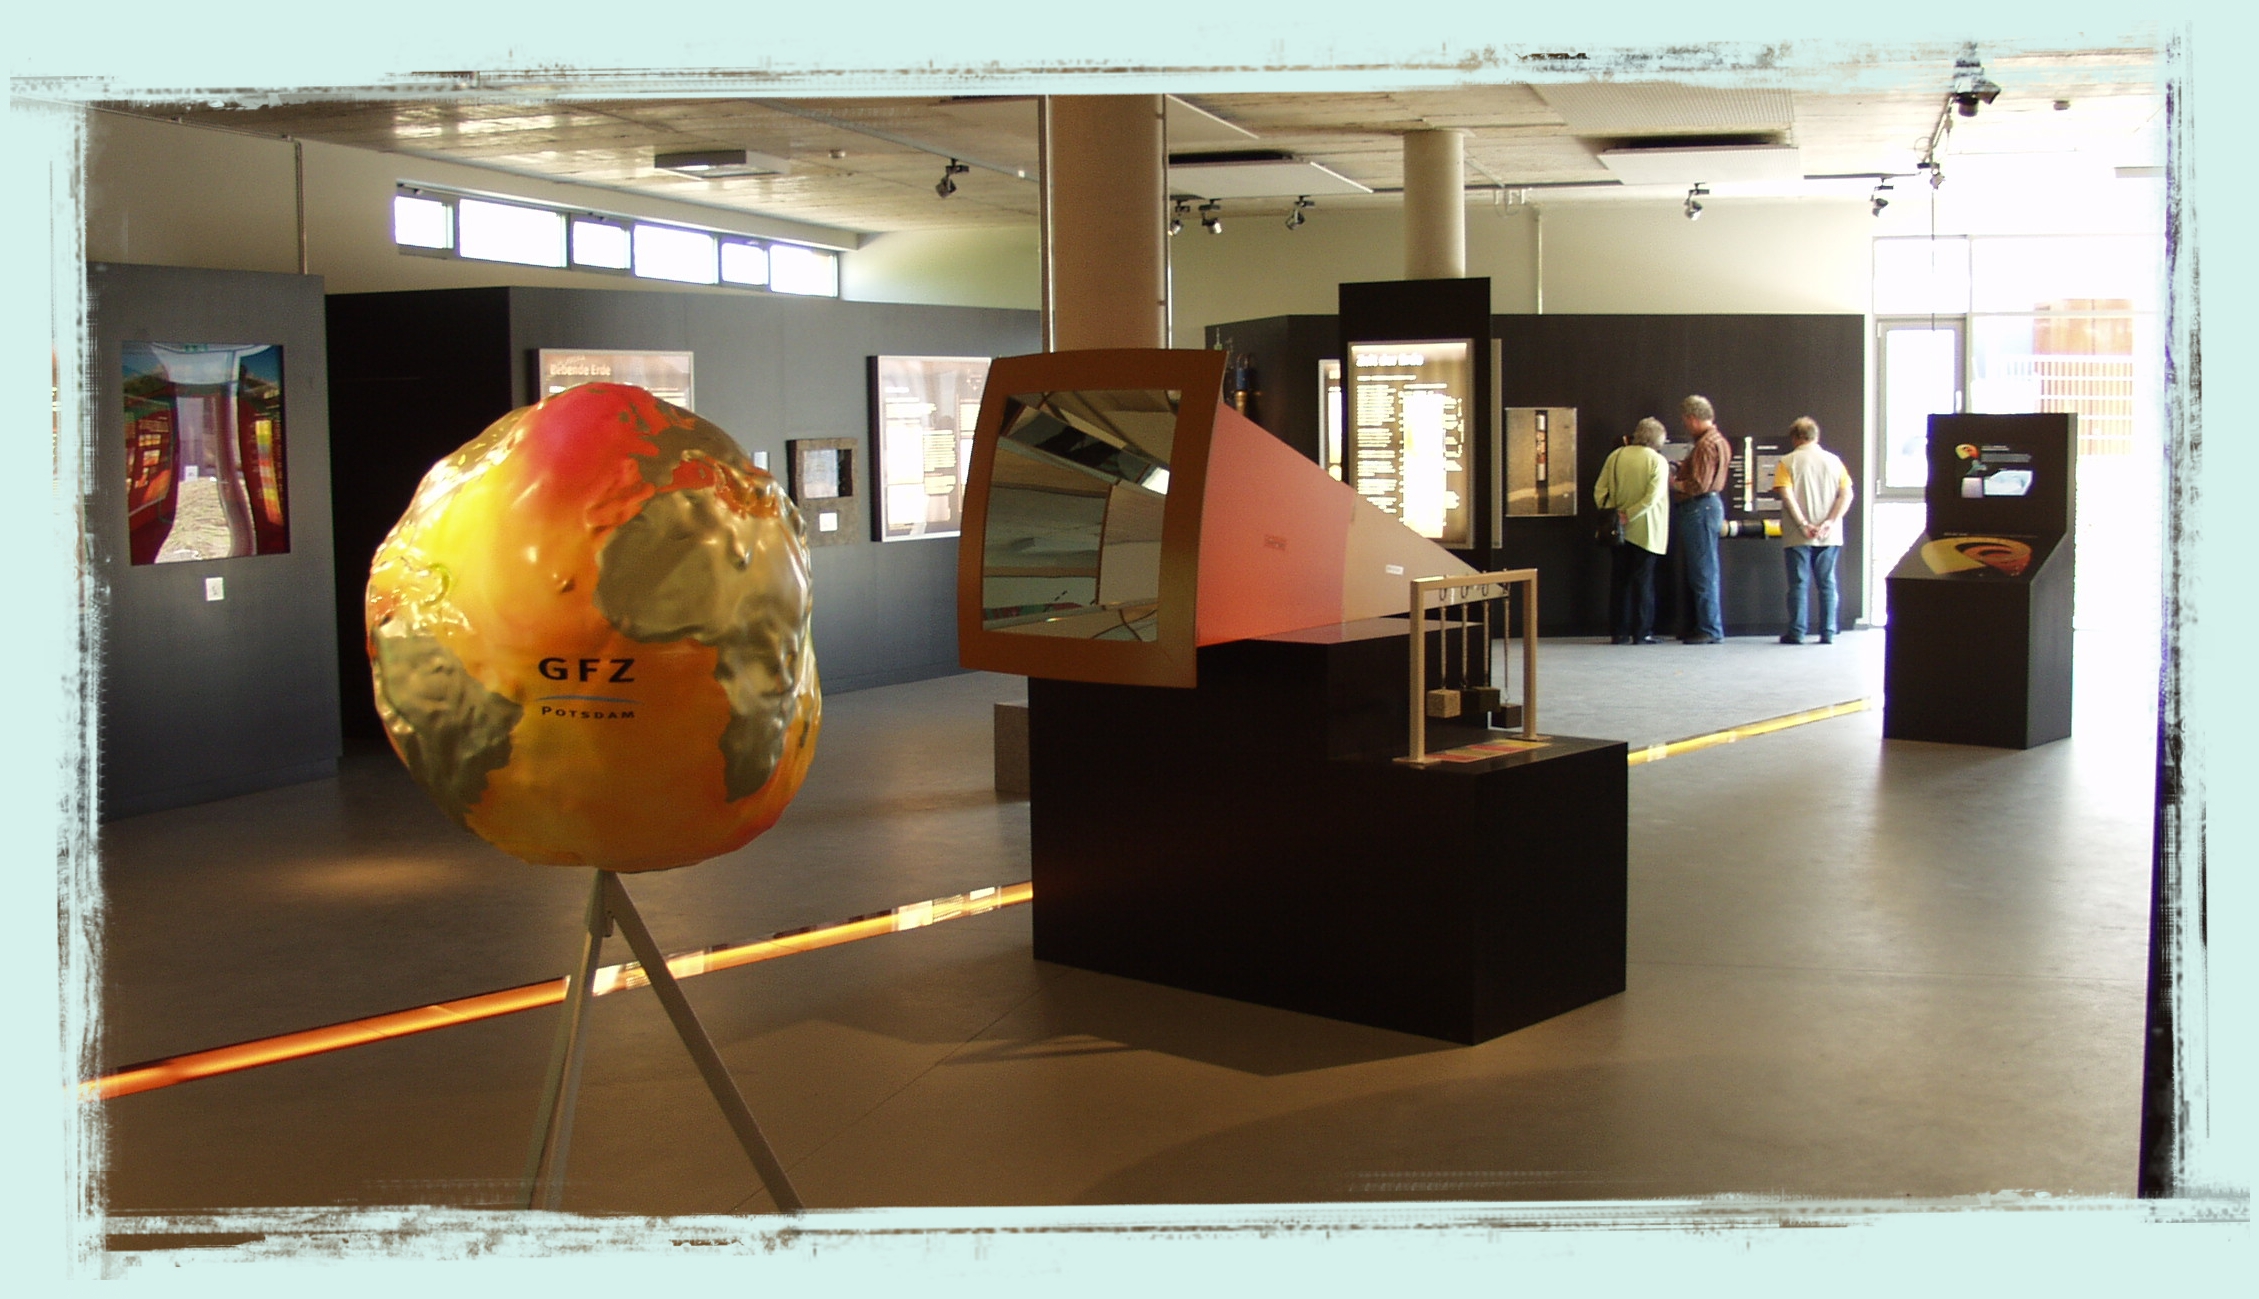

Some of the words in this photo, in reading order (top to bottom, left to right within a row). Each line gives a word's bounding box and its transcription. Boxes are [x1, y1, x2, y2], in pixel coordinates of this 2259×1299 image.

[550, 363, 589, 376] Bebende
[591, 364, 611, 376] Erde
[538, 657, 635, 683] GFZ
